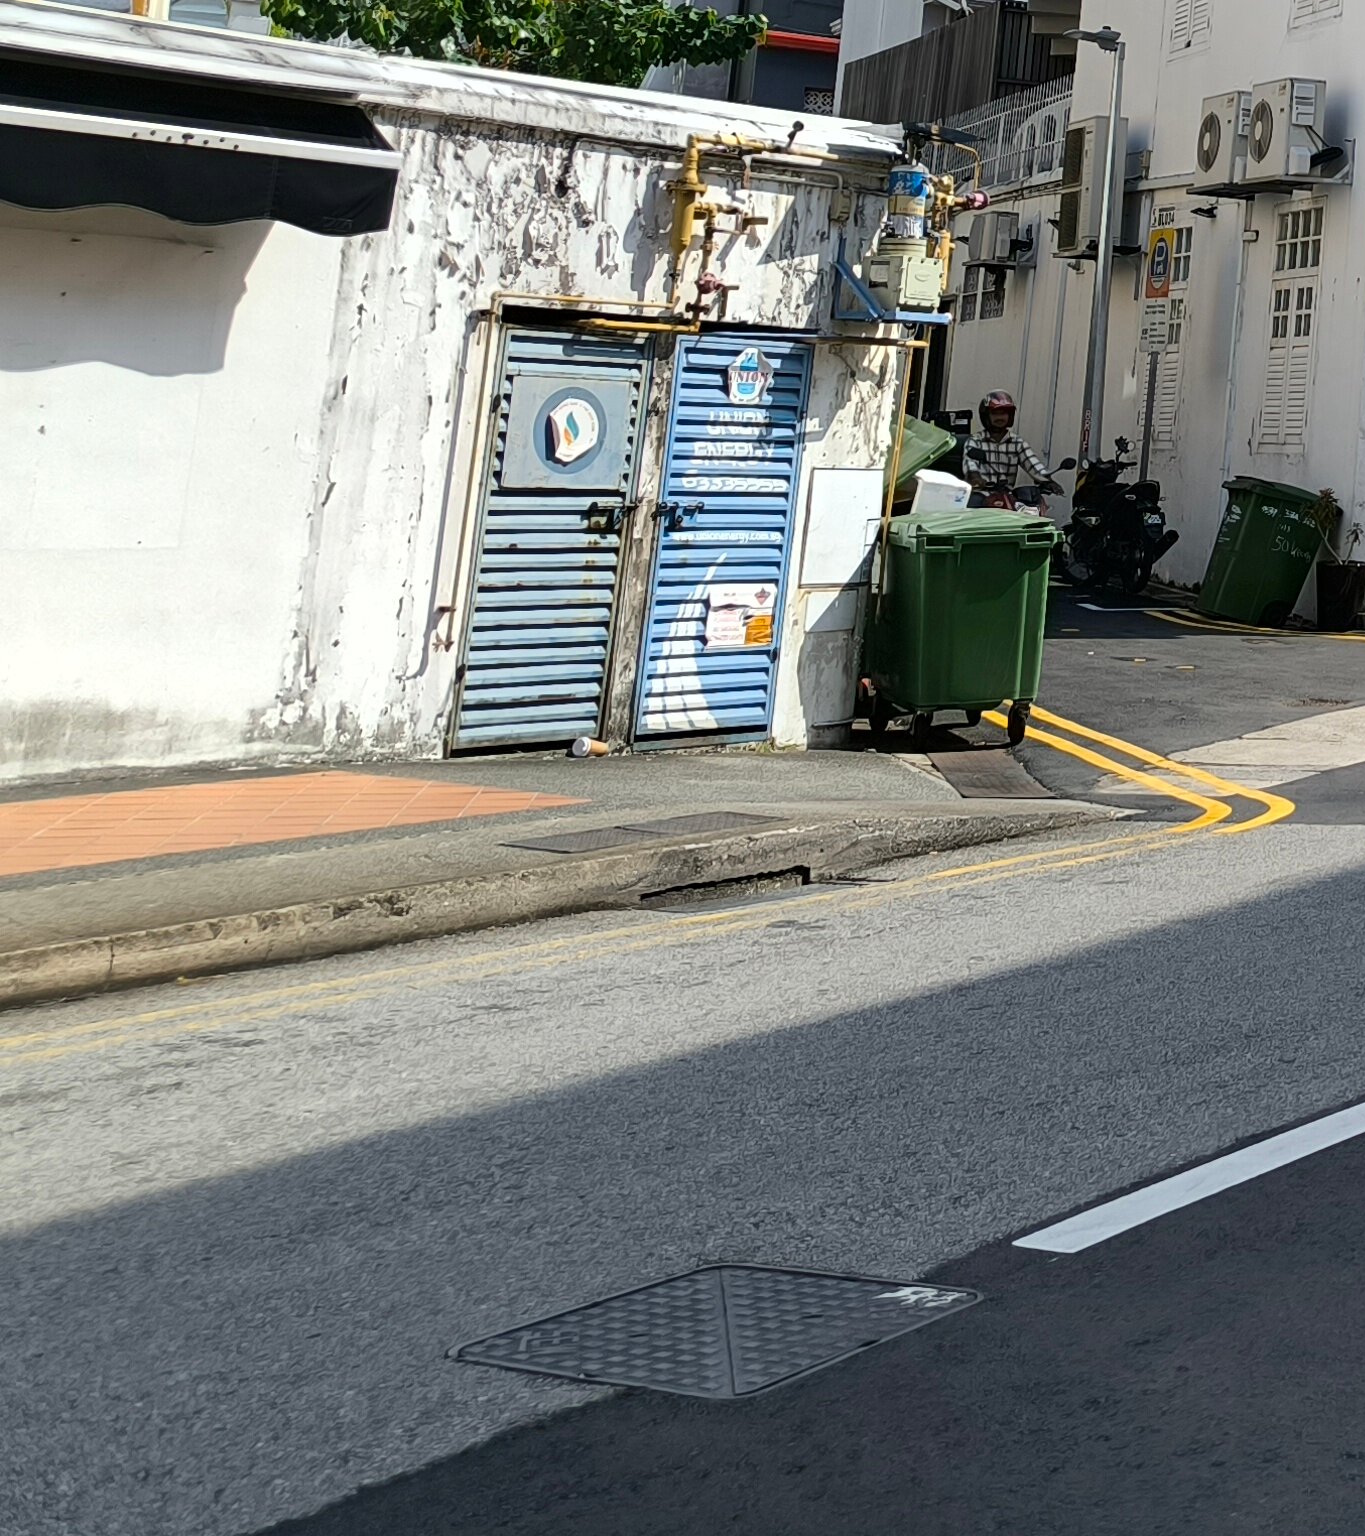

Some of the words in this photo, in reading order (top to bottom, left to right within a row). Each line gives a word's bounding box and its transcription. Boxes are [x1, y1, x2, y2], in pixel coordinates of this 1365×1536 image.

[728, 370, 769, 383] UNION
[706, 410, 771, 436] UNION
[690, 441, 776, 467] ENERGY
